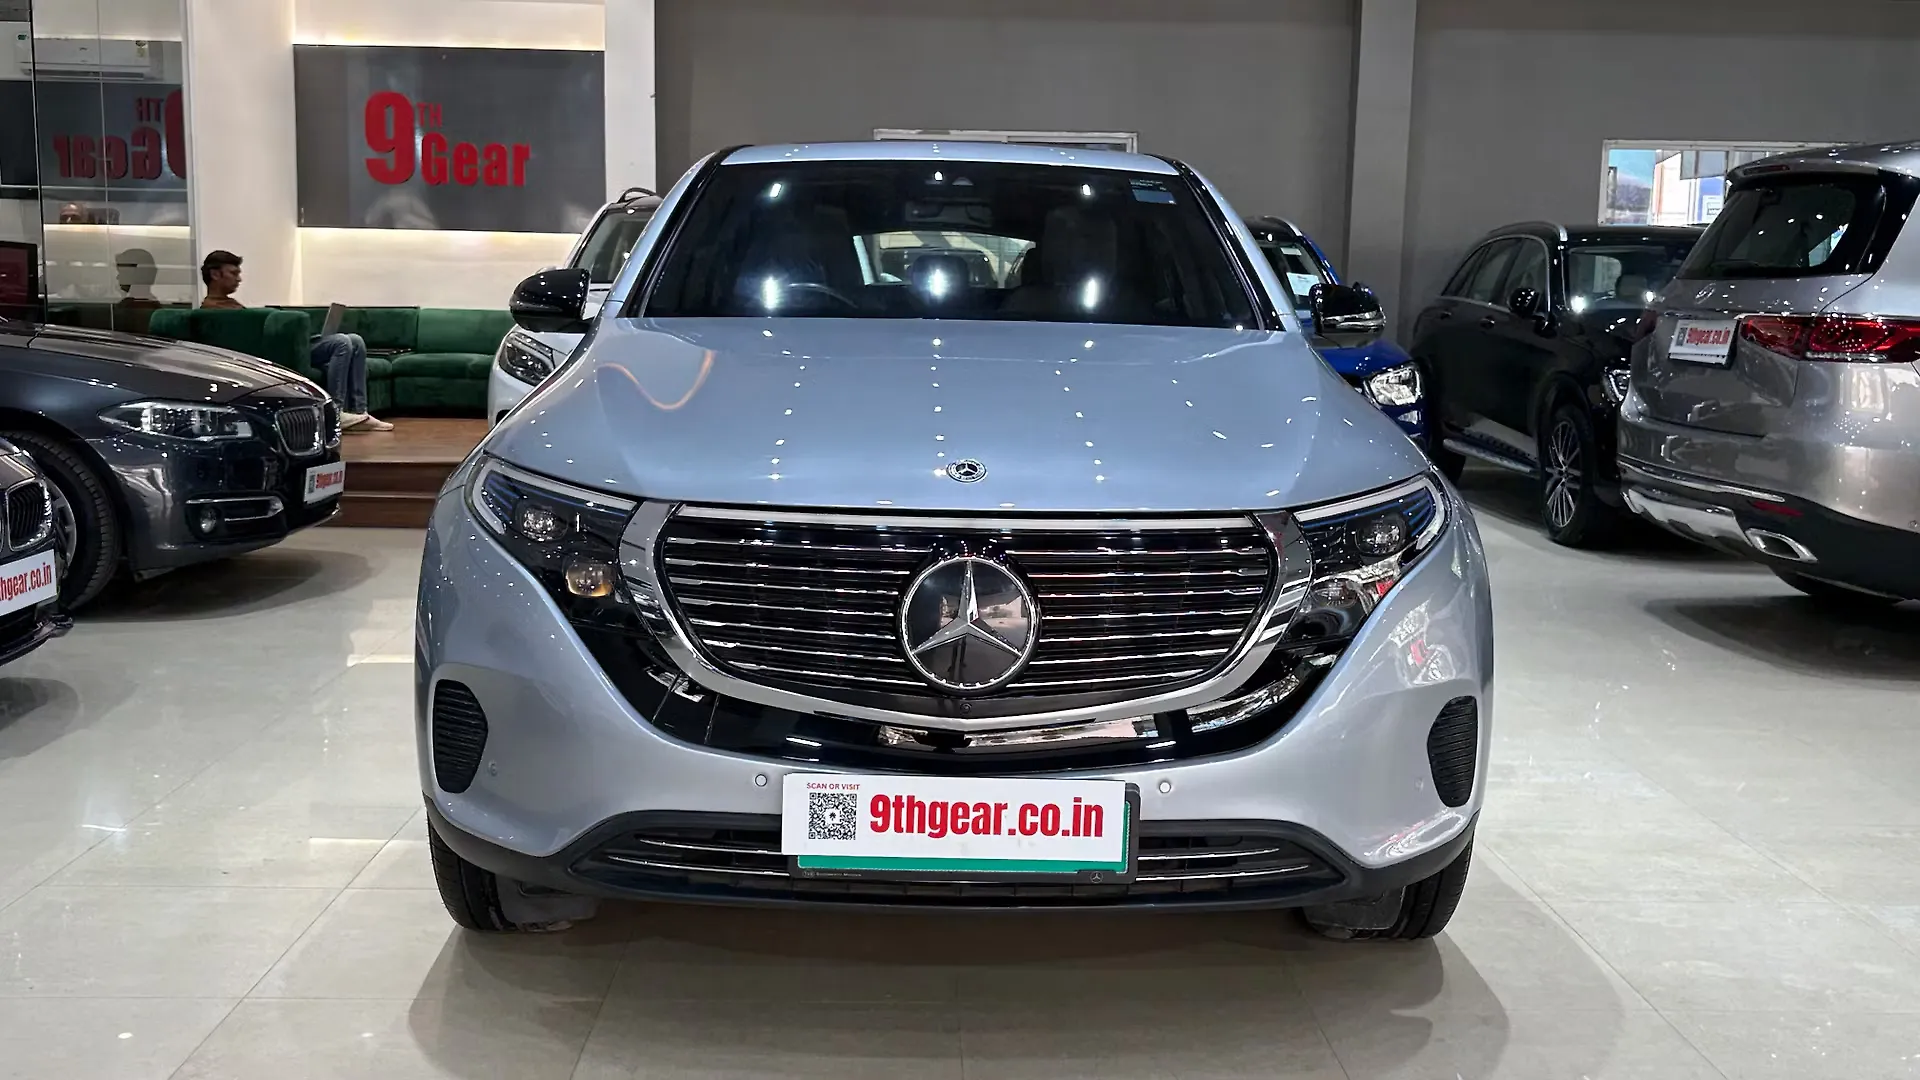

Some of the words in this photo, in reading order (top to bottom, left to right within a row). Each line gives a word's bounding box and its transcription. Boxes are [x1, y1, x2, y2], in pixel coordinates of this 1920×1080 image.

[421, 132, 531, 187] Gear
[0, 562, 52, 601] hgear.co.in
[806, 782, 828, 790] SCAN
[841, 783, 860, 791] VISIT
[870, 794, 1104, 839] 9thgear.co.in
